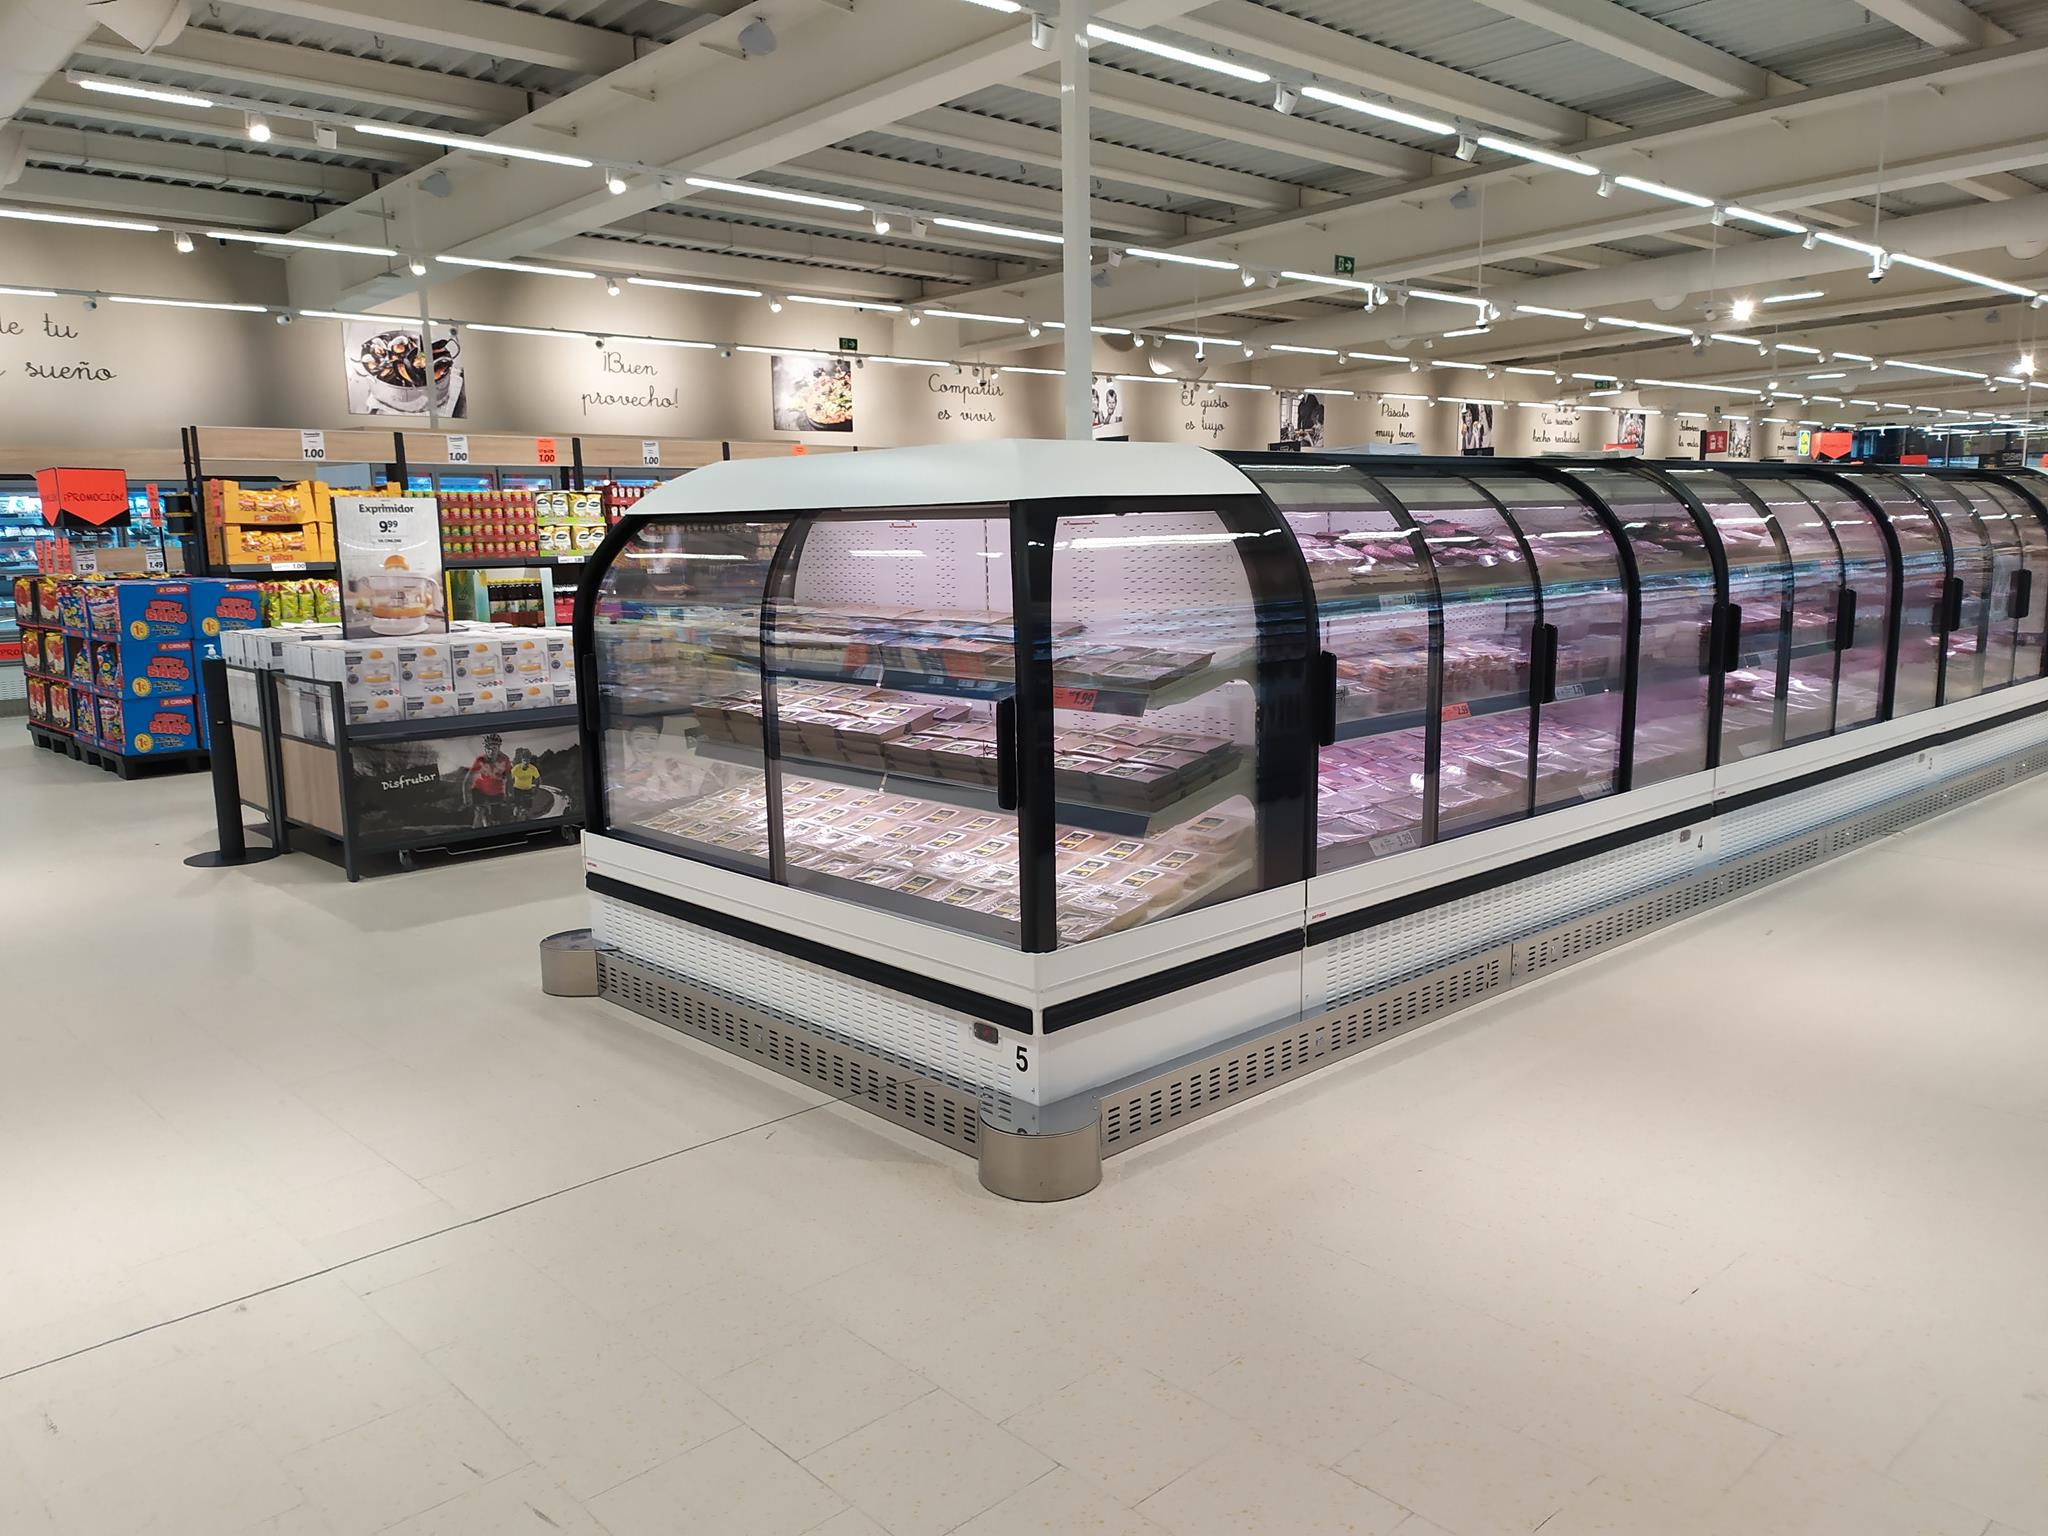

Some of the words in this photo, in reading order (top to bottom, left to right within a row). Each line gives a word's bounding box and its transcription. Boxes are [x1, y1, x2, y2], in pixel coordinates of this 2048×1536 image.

[43, 313, 78, 338] tu
[25, 361, 117, 381] sueño
[603, 351, 658, 376] ¡Buen
[928, 373, 1004, 404] Compartir
[582, 385, 678, 416] provecho!
[1181, 389, 1196, 406] El
[1200, 395, 1229, 415] gusto
[938, 409, 952, 420] es
[960, 408, 996, 422] vivir
[1185, 421, 1195, 430] es
[1375, 430, 1394, 444] muy
[303, 448, 324, 458] 1.00
[449, 452, 467, 462] 1.00
[538, 454, 556, 463] 1.00
[644, 456, 659, 465] 1.00
[359, 504, 415, 515] Exprimidor
[79, 563, 95, 571] 1.99
[149, 561, 163, 569] 1.49
[1073, 690, 1094, 706] 1.99
[381, 771, 436, 791] Disfrutar
[1697, 834, 1703, 851] 4
[1016, 1045, 1028, 1072] 5
